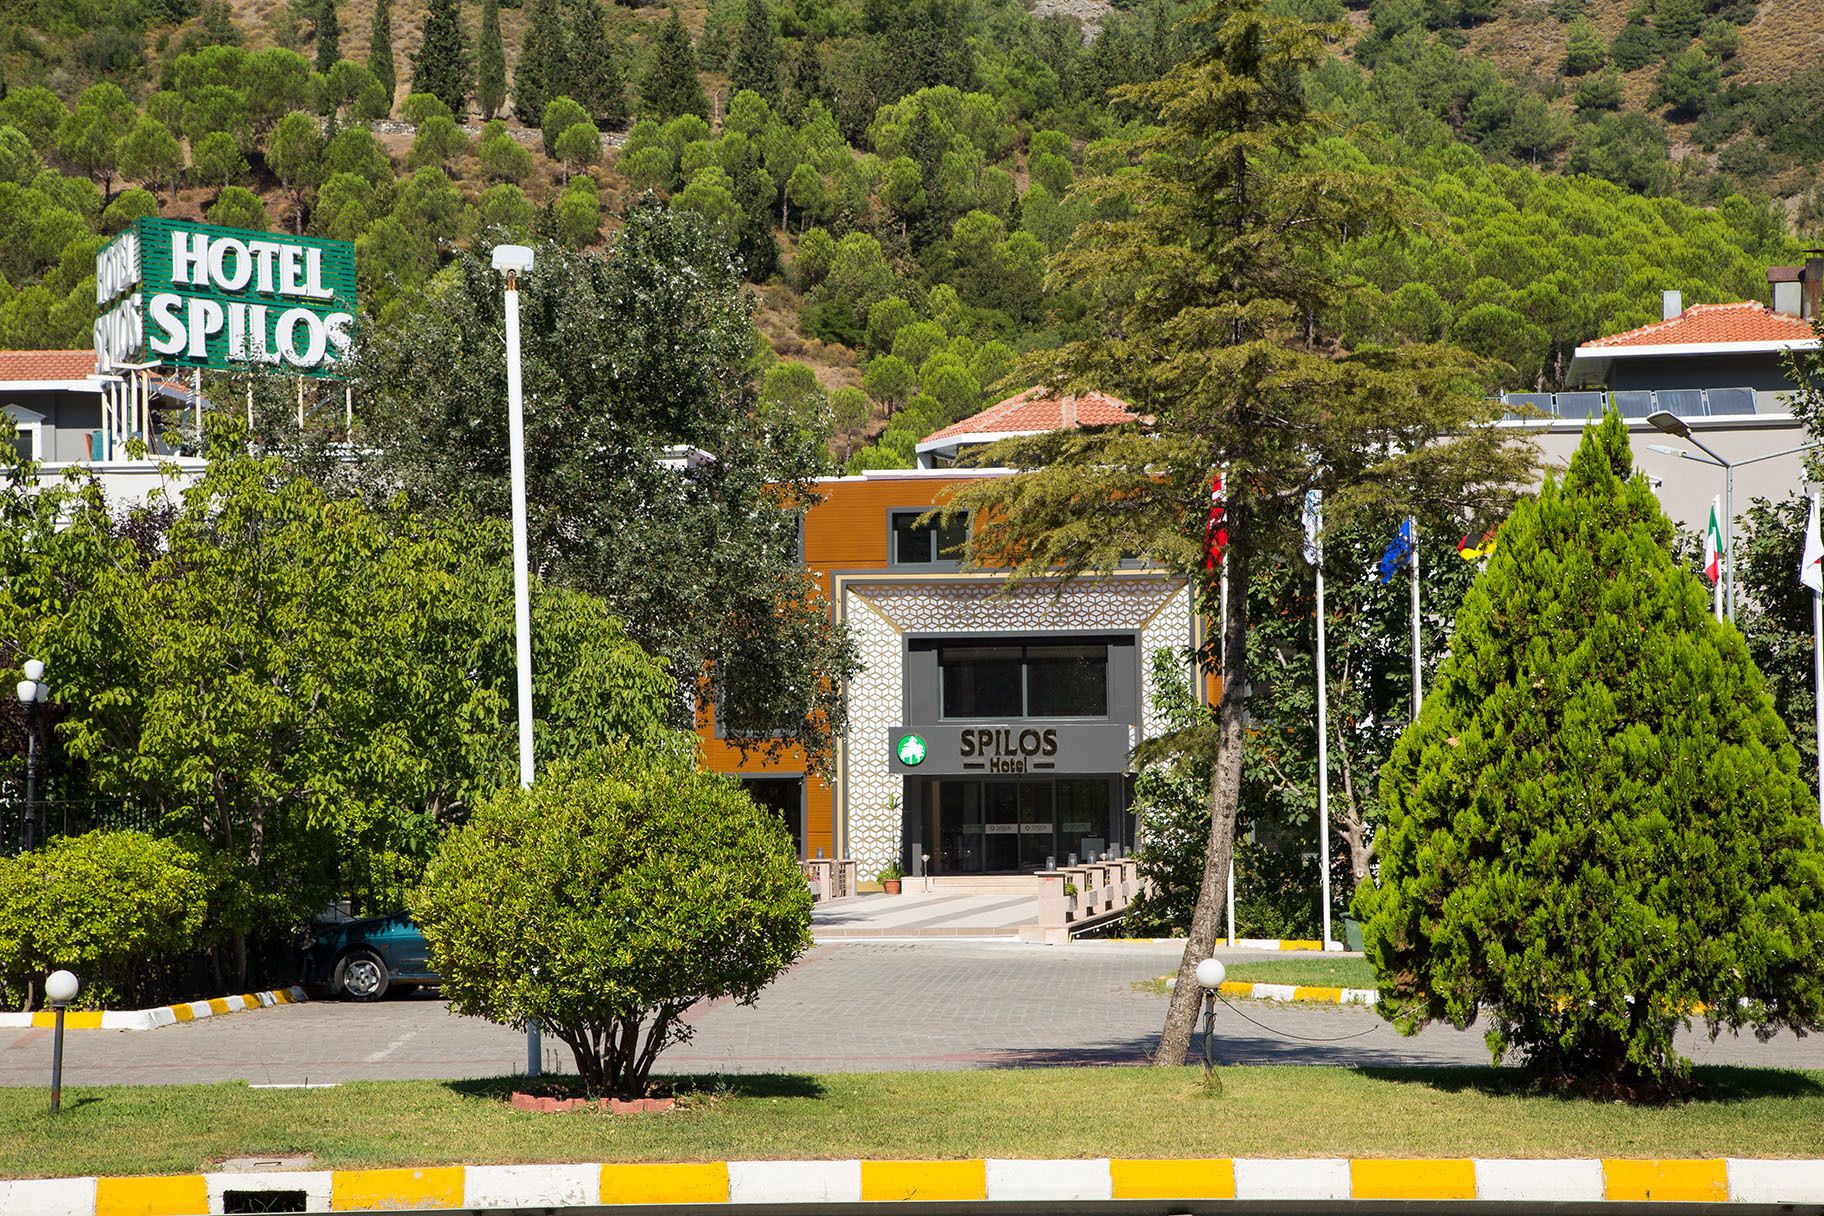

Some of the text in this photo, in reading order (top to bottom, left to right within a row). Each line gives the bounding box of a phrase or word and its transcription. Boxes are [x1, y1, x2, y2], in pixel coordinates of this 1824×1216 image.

[170, 230, 334, 299] HOTEL
[149, 293, 354, 367] SPILOS
[960, 728, 1058, 757] SPILOS
[989, 756, 1028, 773] Hotel
